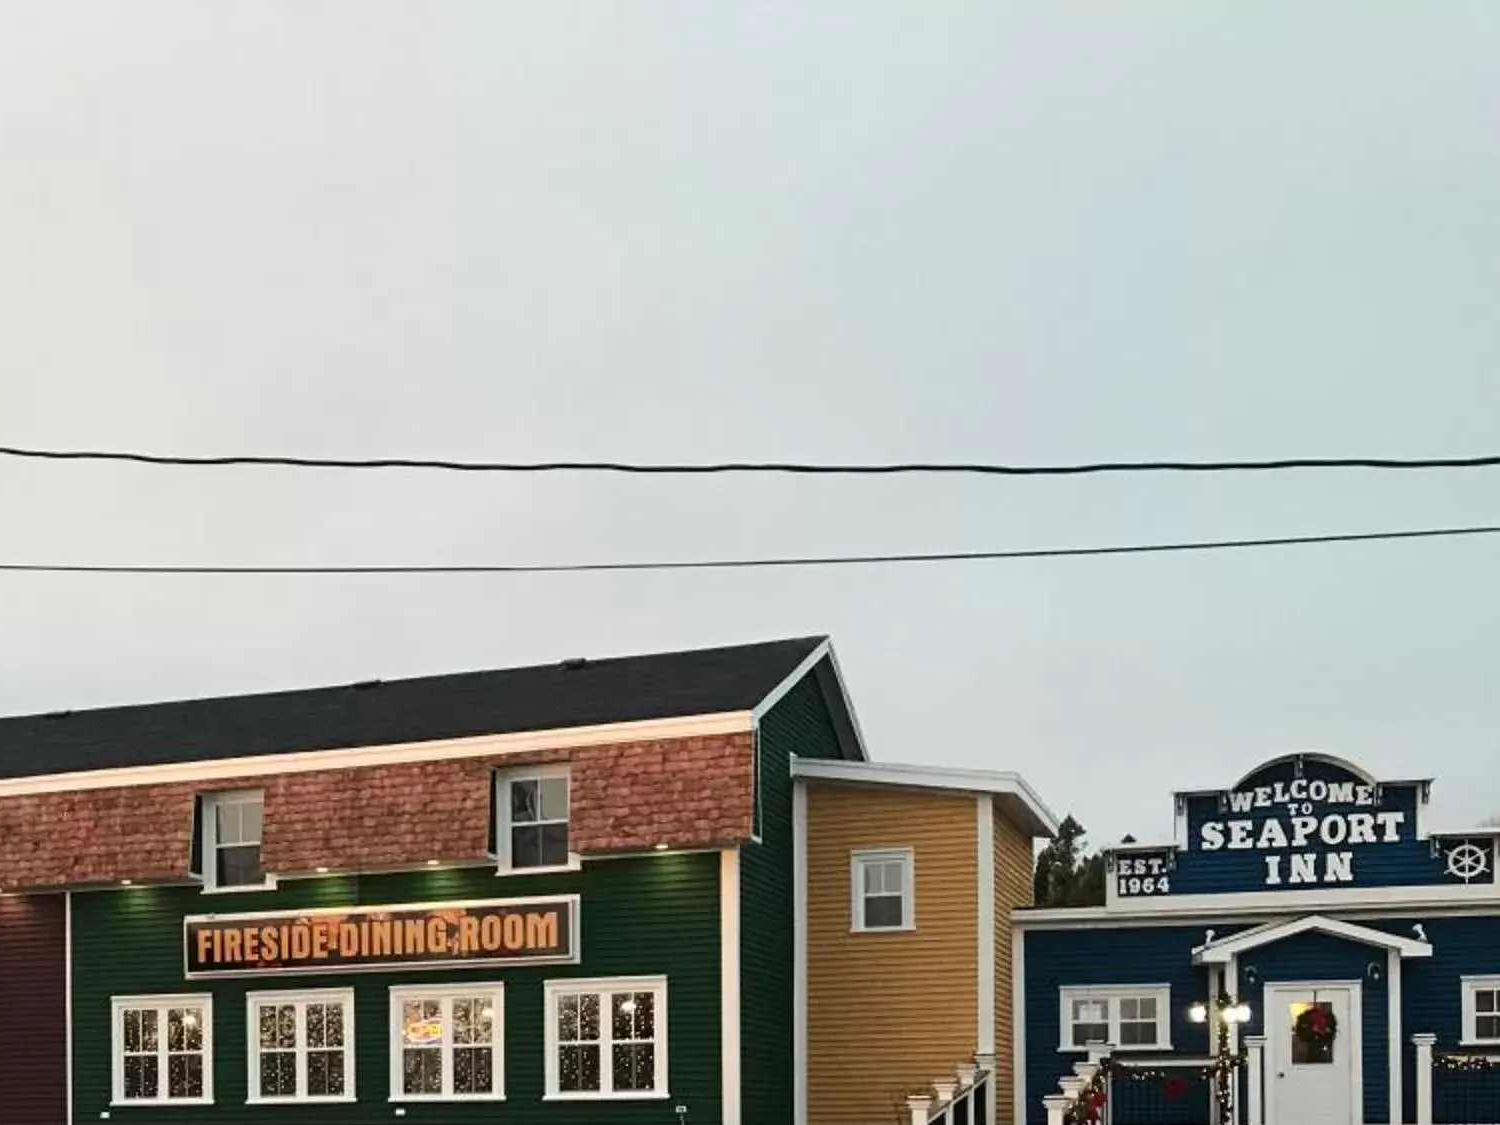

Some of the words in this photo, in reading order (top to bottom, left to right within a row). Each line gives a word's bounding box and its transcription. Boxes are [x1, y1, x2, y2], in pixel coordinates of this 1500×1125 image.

[1230, 780, 1373, 813] WELCOME
[1288, 803, 1313, 815] TO
[1200, 812, 1405, 850] SEAPORT
[1119, 859, 1167, 875] EST.
[1265, 852, 1354, 884] INN
[1119, 877, 1170, 894] 1964
[198, 923, 329, 962] FIRESIDE
[340, 920, 447, 957] DINING
[461, 911, 559, 953] ROOM
